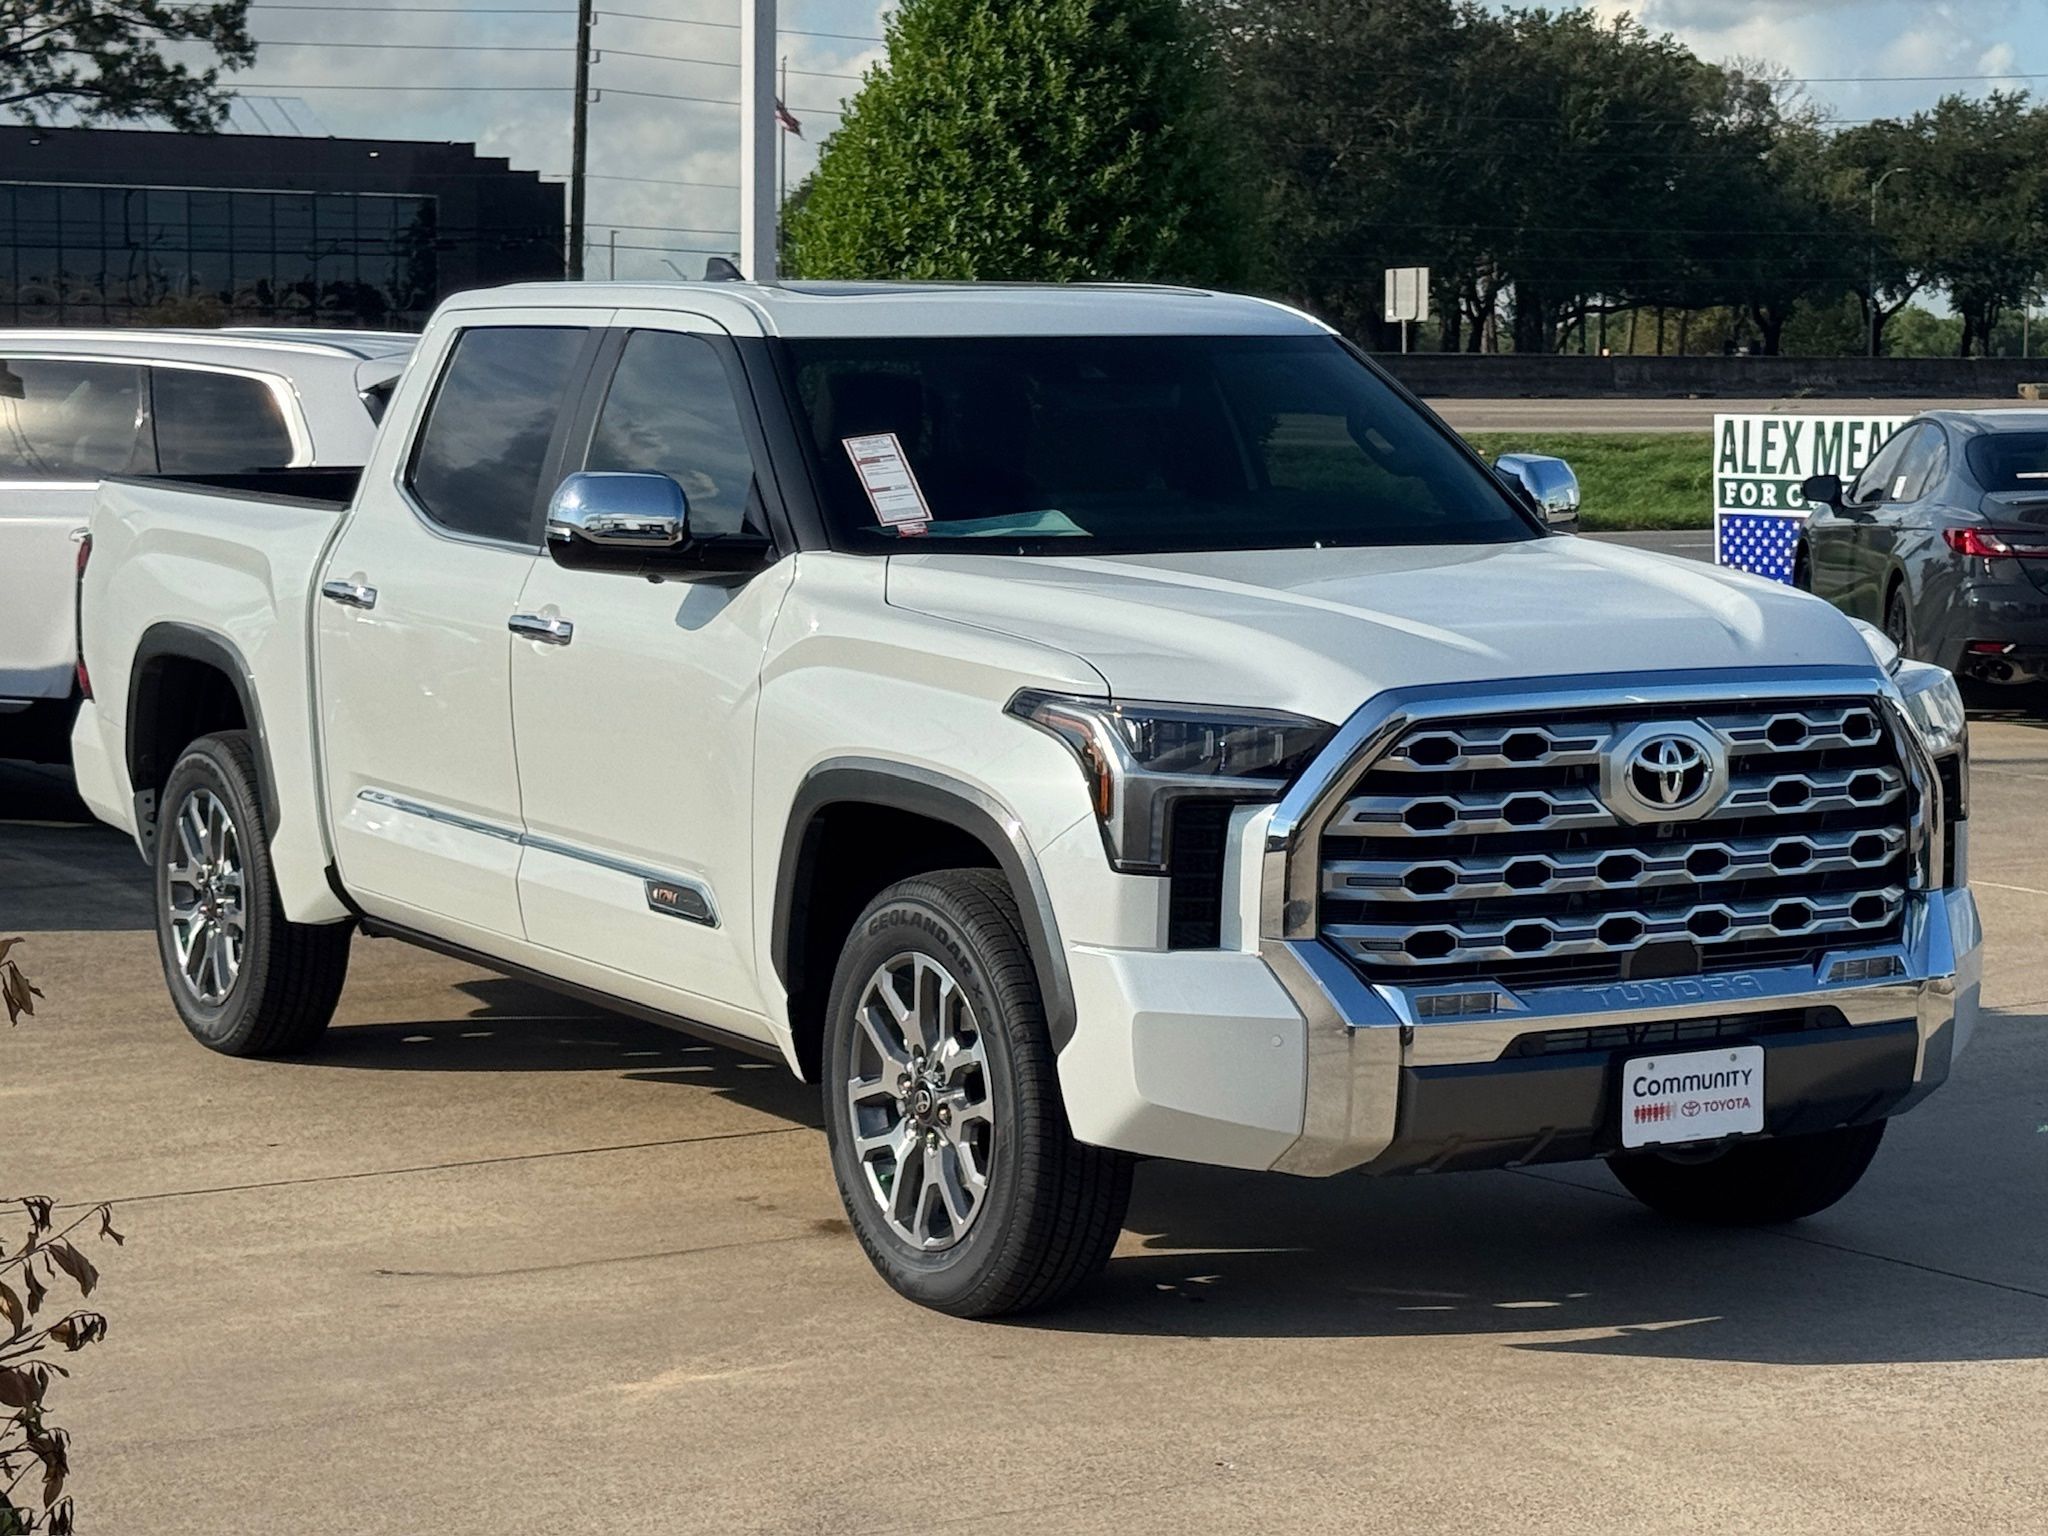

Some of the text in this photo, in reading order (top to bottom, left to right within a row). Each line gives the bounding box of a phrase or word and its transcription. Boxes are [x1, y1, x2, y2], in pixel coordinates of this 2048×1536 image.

[1718, 420, 1903, 476] ALEX MEA
[1724, 482, 1777, 507] FOR
[868, 909, 974, 977] GEOLANDAR
[1582, 974, 1764, 1006] TUNDRA
[1704, 1097, 1751, 1112] TOYOTA
